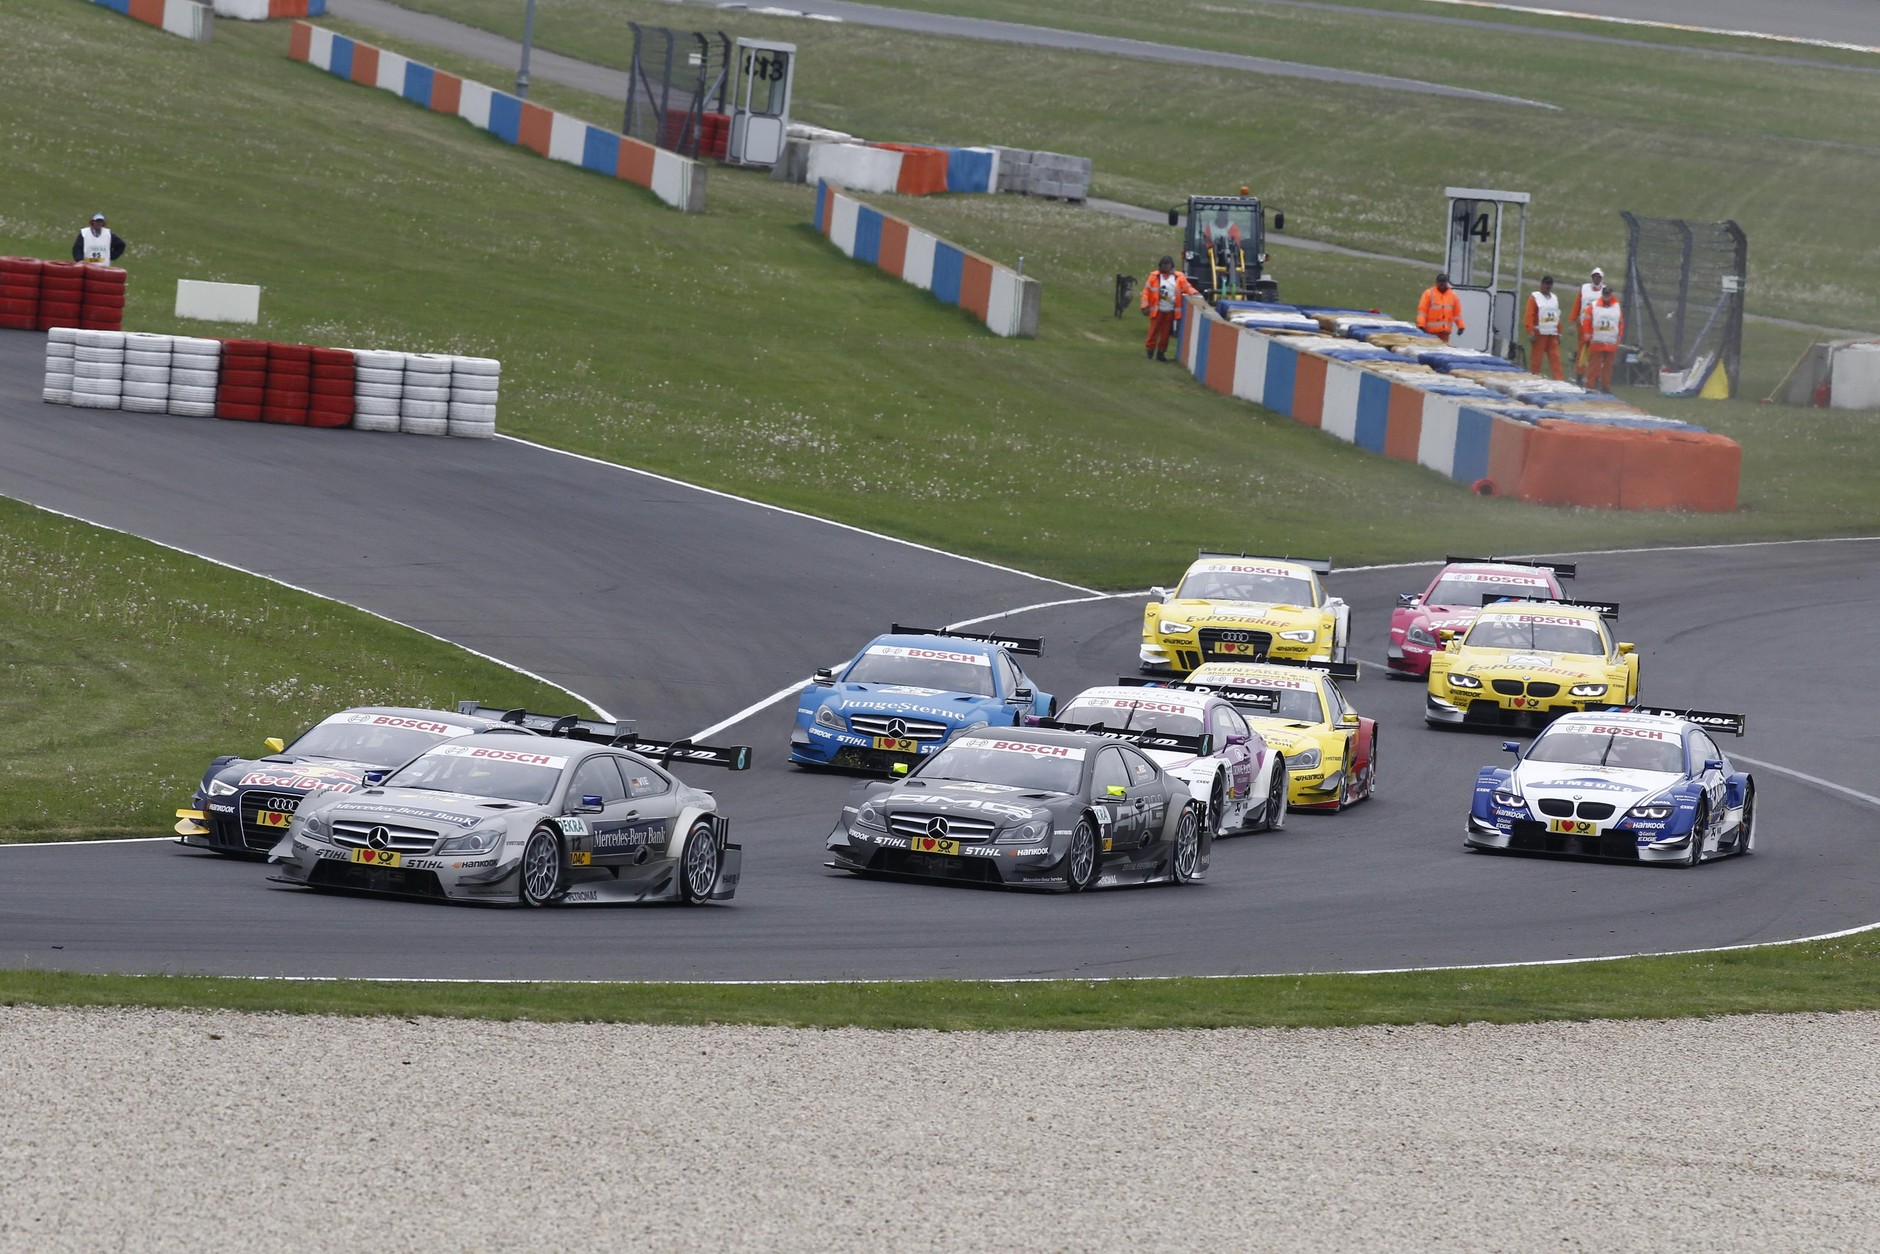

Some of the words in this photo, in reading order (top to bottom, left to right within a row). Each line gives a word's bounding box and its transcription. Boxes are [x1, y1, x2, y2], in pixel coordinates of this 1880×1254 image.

[1458, 212, 1491, 243] 14
[1231, 565, 1290, 576] BOSCH
[1476, 575, 1536, 585] BOSCH
[1520, 615, 1581, 626] BOSCH
[907, 649, 976, 663] BOSCH
[1233, 677, 1301, 689] BOSCH
[1113, 700, 1186, 714] BOSCH
[372, 716, 448, 733] BOSCH
[1592, 725, 1663, 740] BOSCH
[836, 735, 868, 747] STIHL
[471, 748, 551, 765] BOSCH
[993, 742, 1069, 757] BOSCH
[239, 772, 296, 788] Red
[1541, 779, 1634, 793] SAMSUNG
[335, 802, 432, 818] Mercedes-Benz
[435, 811, 477, 827] Bank
[1112, 802, 1165, 833] AMG
[594, 828, 648, 848] Mercedes-Benz
[647, 826, 666, 844] Bank
[874, 836, 907, 848] STIHL
[315, 848, 348, 861] STIHL
[964, 846, 1002, 857] STIHL
[406, 859, 445, 869] STIHL
